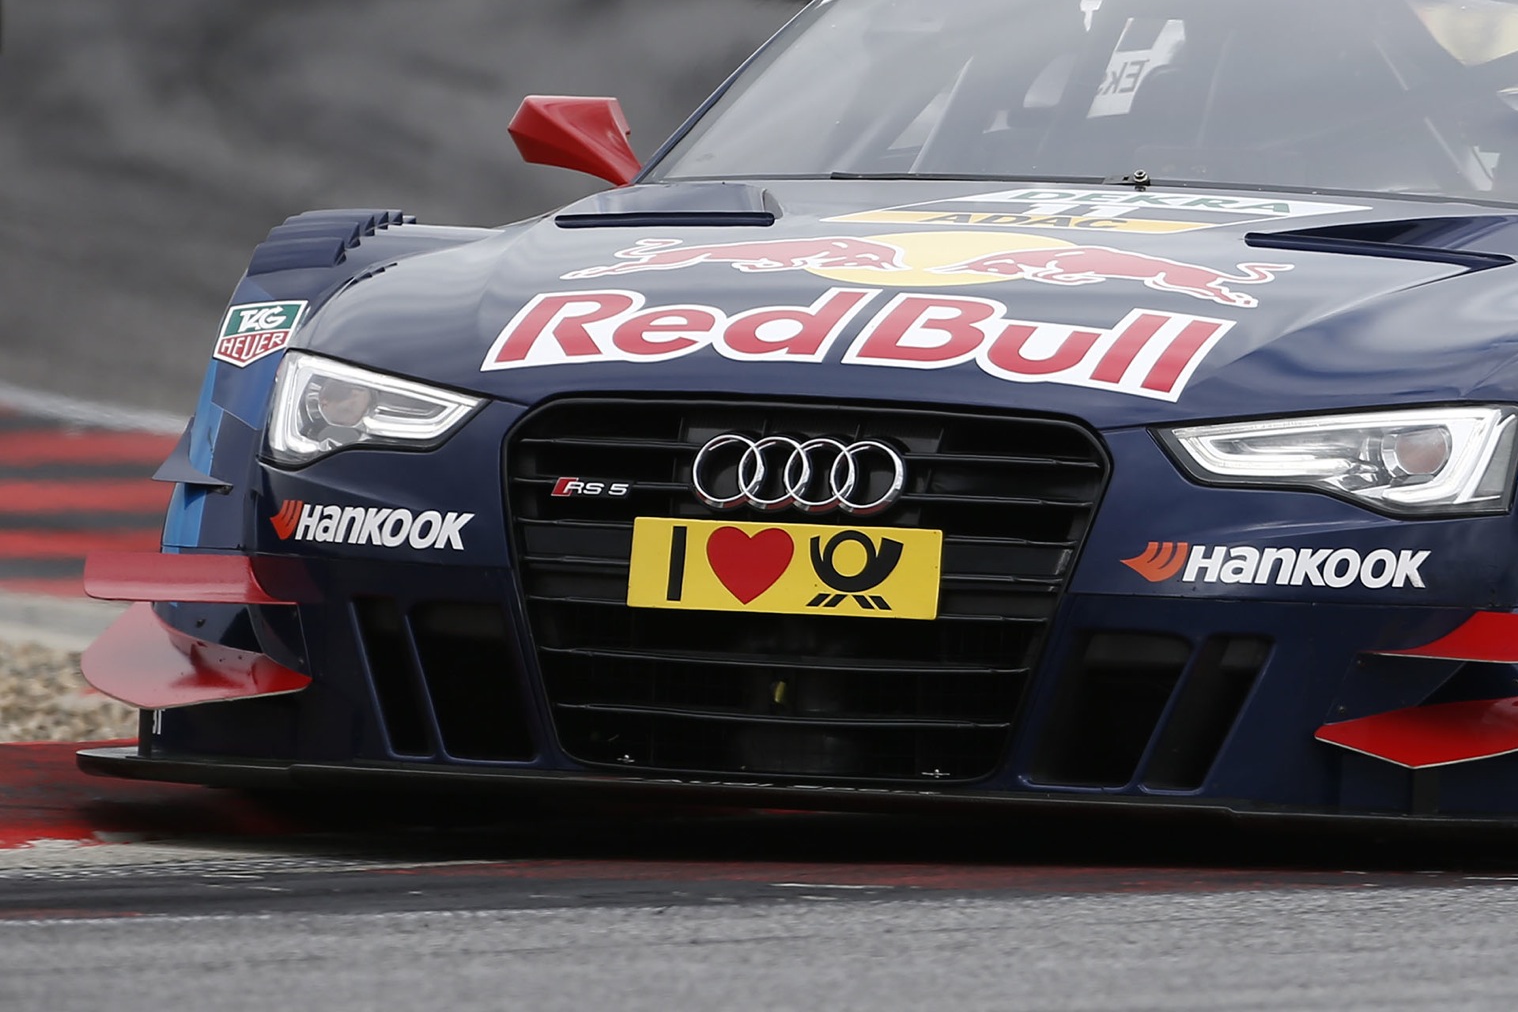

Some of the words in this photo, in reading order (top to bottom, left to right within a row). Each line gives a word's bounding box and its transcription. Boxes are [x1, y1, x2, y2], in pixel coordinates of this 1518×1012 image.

[1006, 190, 1294, 214] DEKRA
[916, 213, 1130, 229] ADAC
[237, 305, 287, 333] TAG
[220, 332, 285, 360] HEUER
[482, 288, 880, 372] Red
[842, 291, 1236, 402] Bull
[562, 481, 605, 495] RS
[608, 483, 629, 495] 5
[668, 525, 687, 601] I
